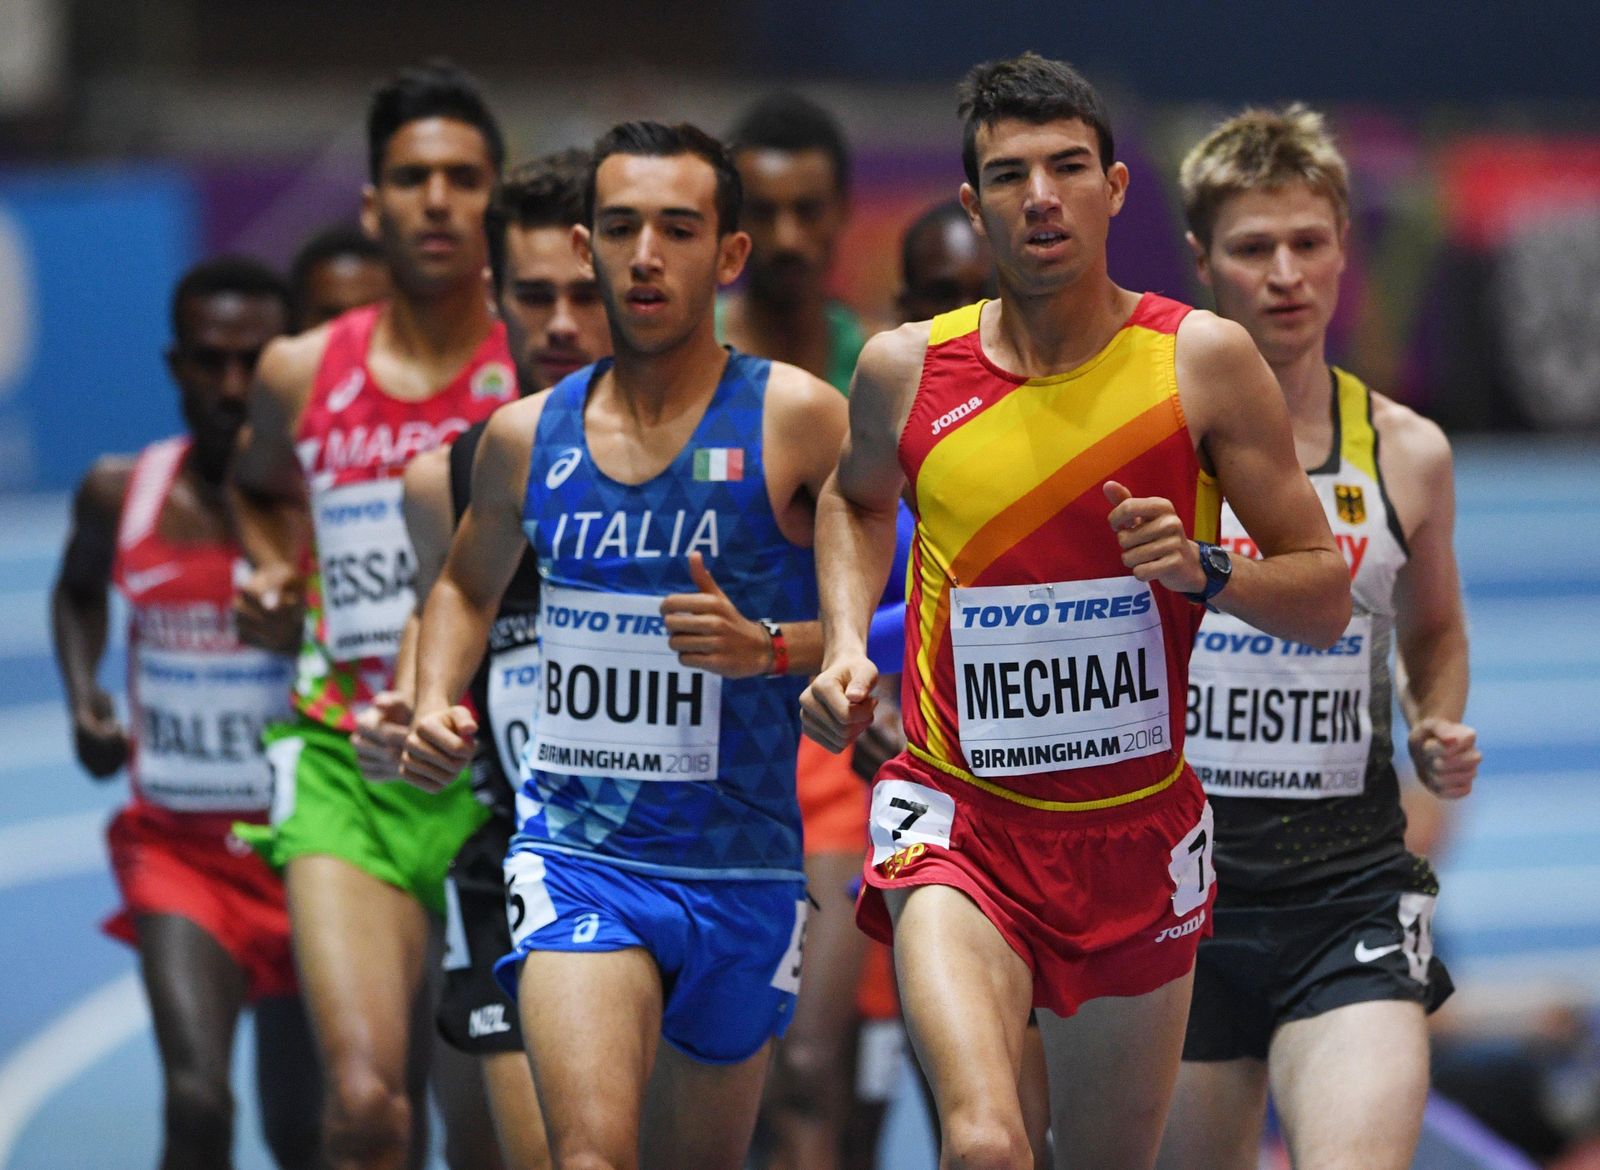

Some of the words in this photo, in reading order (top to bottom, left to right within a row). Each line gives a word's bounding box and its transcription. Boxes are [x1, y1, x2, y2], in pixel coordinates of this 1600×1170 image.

[552, 509, 719, 560] ITALIA
[546, 605, 610, 632] TOYO
[615, 613, 671, 636] TIR
[962, 603, 1049, 628] TOYO
[1055, 590, 1151, 623] TIRES
[503, 665, 538, 688] TO
[547, 660, 703, 726] BOUIH
[963, 647, 1159, 720] MECHAAL
[1186, 684, 1361, 744] BLEISTEIN
[538, 743, 662, 772] BIRMINGHAM
[665, 753, 711, 774] 2018
[971, 736, 1121, 768] BIRMINGHAM
[1123, 725, 1163, 752] 2018
[889, 797, 929, 841] 7
